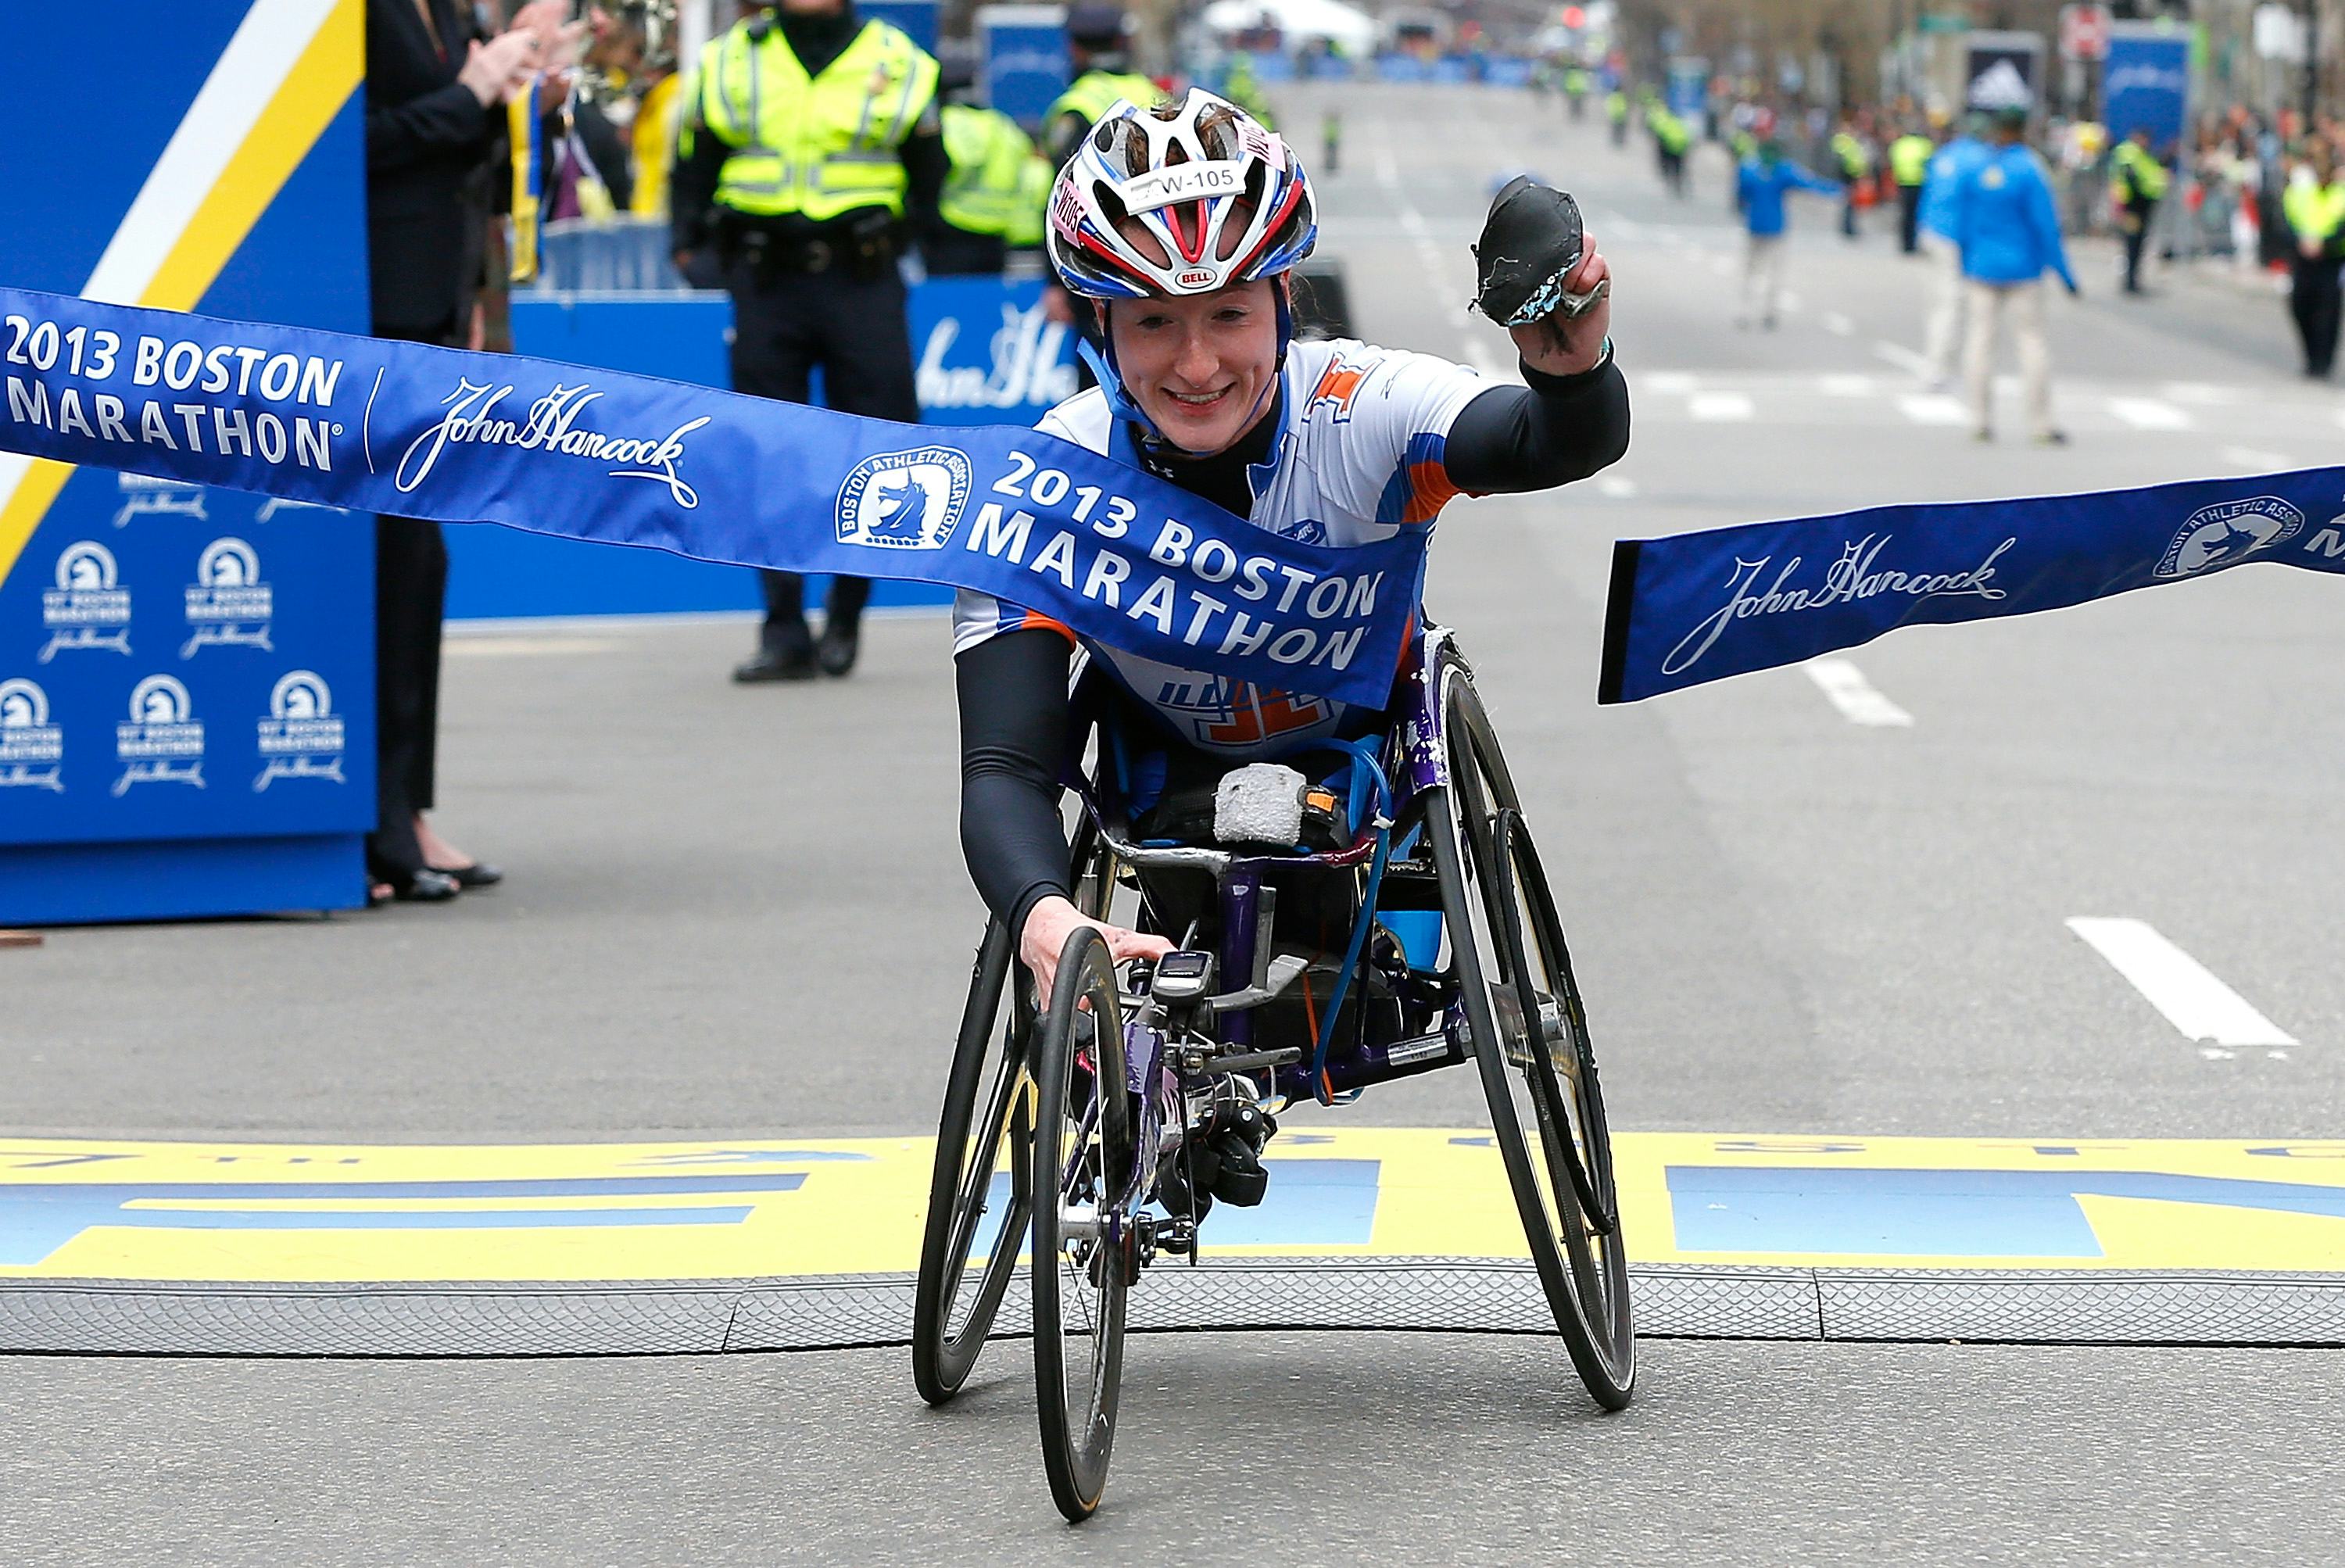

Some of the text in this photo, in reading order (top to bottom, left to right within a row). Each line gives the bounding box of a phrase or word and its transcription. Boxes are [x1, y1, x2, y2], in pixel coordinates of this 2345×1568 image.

[1057, 187, 1084, 232] W105
[1162, 170, 1233, 194] W-105
[1182, 273, 1210, 283] BELL
[5, 315, 343, 406] 2013 BOSTON
[396, 377, 712, 509] John Hancock
[841, 467, 872, 533] BOSTON
[871, 450, 951, 471] ATHLETIC
[992, 450, 1384, 619] 2013 BOSTON
[2188, 500, 2266, 529] ATHLETIC
[965, 503, 1365, 671] MARATHON
[1662, 533, 2017, 675] John Hancock
